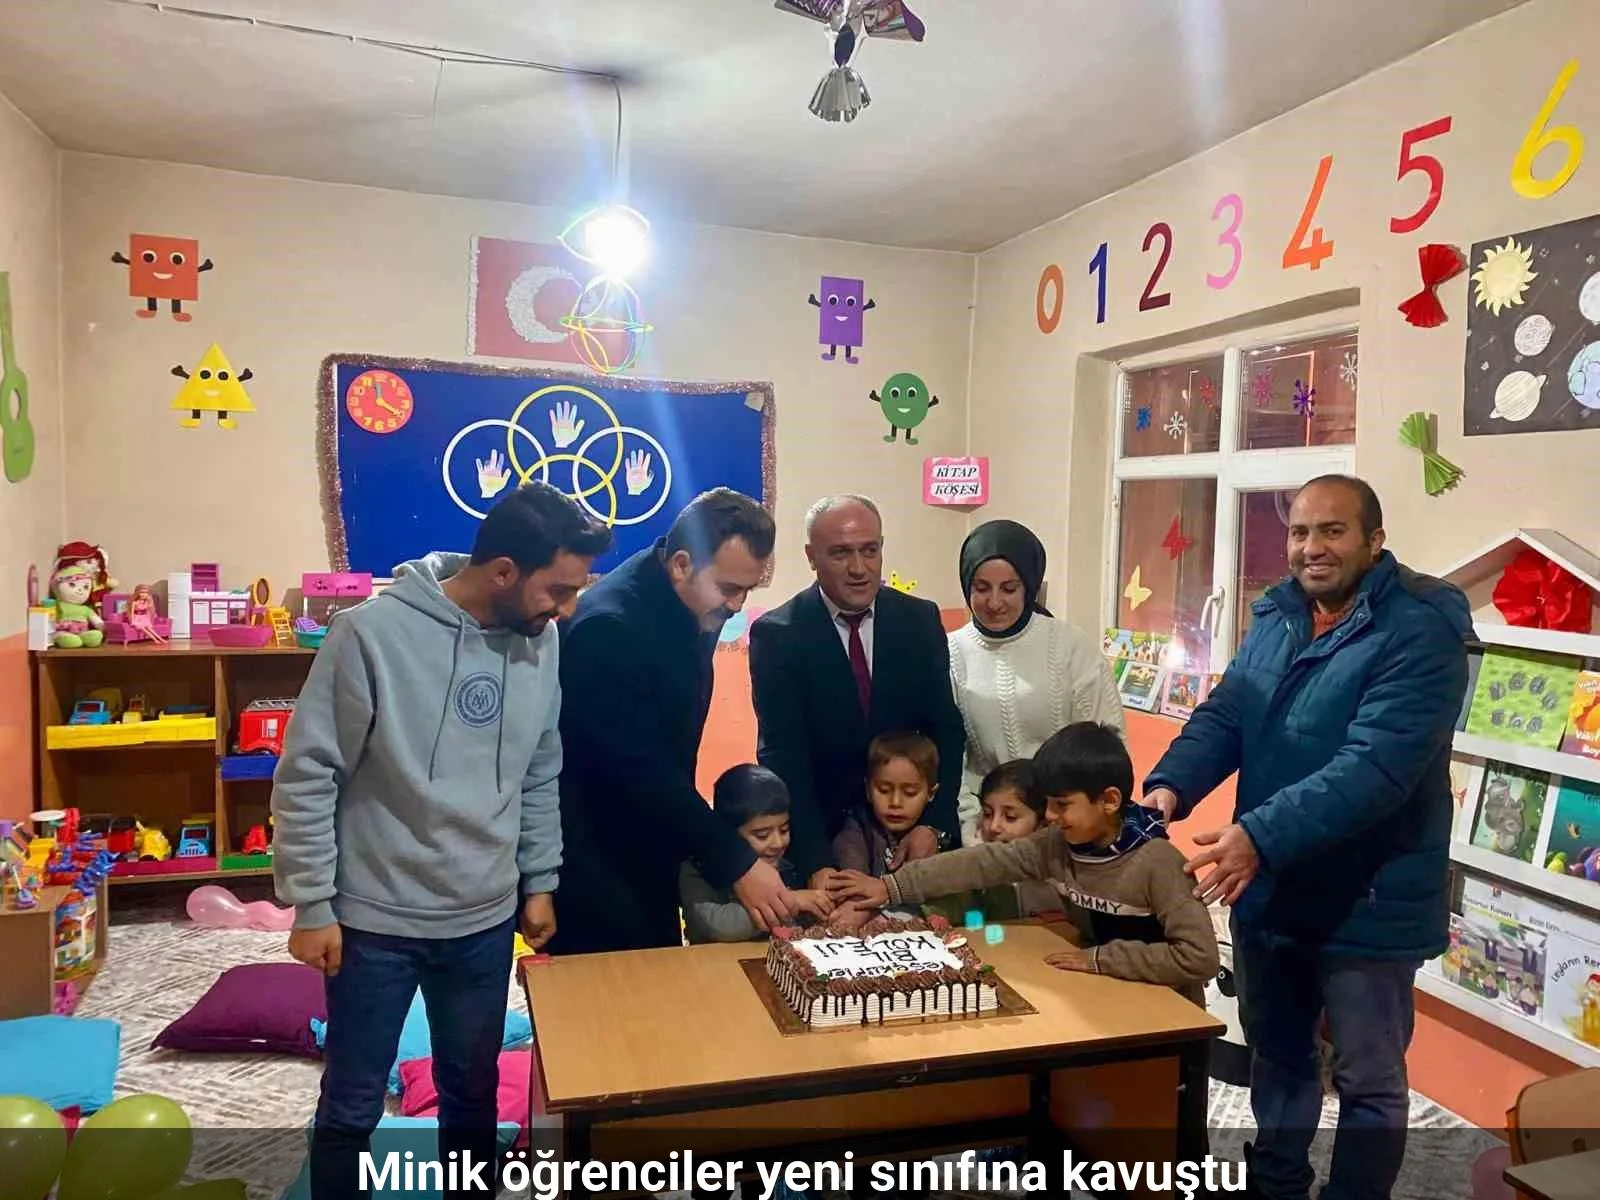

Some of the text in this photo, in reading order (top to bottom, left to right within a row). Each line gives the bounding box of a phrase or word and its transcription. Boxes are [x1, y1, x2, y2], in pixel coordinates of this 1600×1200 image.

[1036, 58, 1585, 334] 0 1 2 3 4 5 6
[937, 464, 977, 478] KİTAP
[1069, 891, 1122, 914] OMMY
